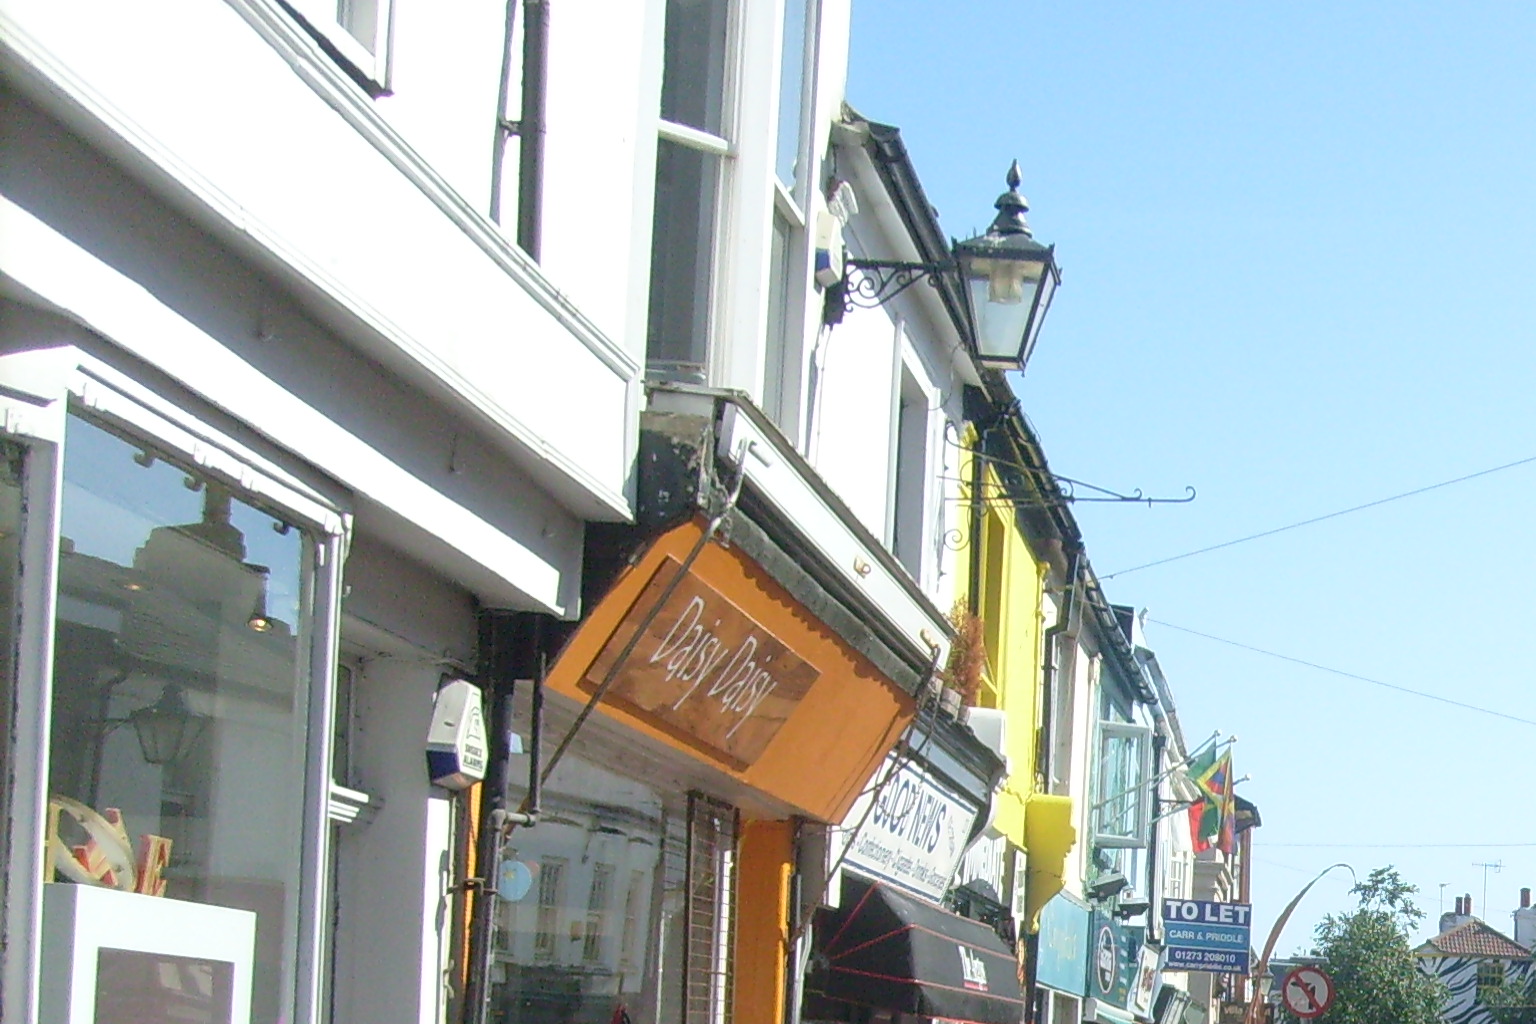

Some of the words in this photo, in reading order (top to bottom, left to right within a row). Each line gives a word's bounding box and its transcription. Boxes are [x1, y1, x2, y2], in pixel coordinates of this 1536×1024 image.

[650, 596, 728, 710] Daisy
[707, 634, 778, 739] Daisy
[873, 772, 917, 837] GOOD
[907, 789, 947, 854] NEWS
[1166, 900, 1199, 920] TO
[1204, 903, 1249, 924] LET
[1169, 929, 1195, 940] CARR
[1196, 931, 1205, 941] &
[1205, 932, 1244, 943] PRIDDLE
[1175, 950, 1202, 960] 01273
